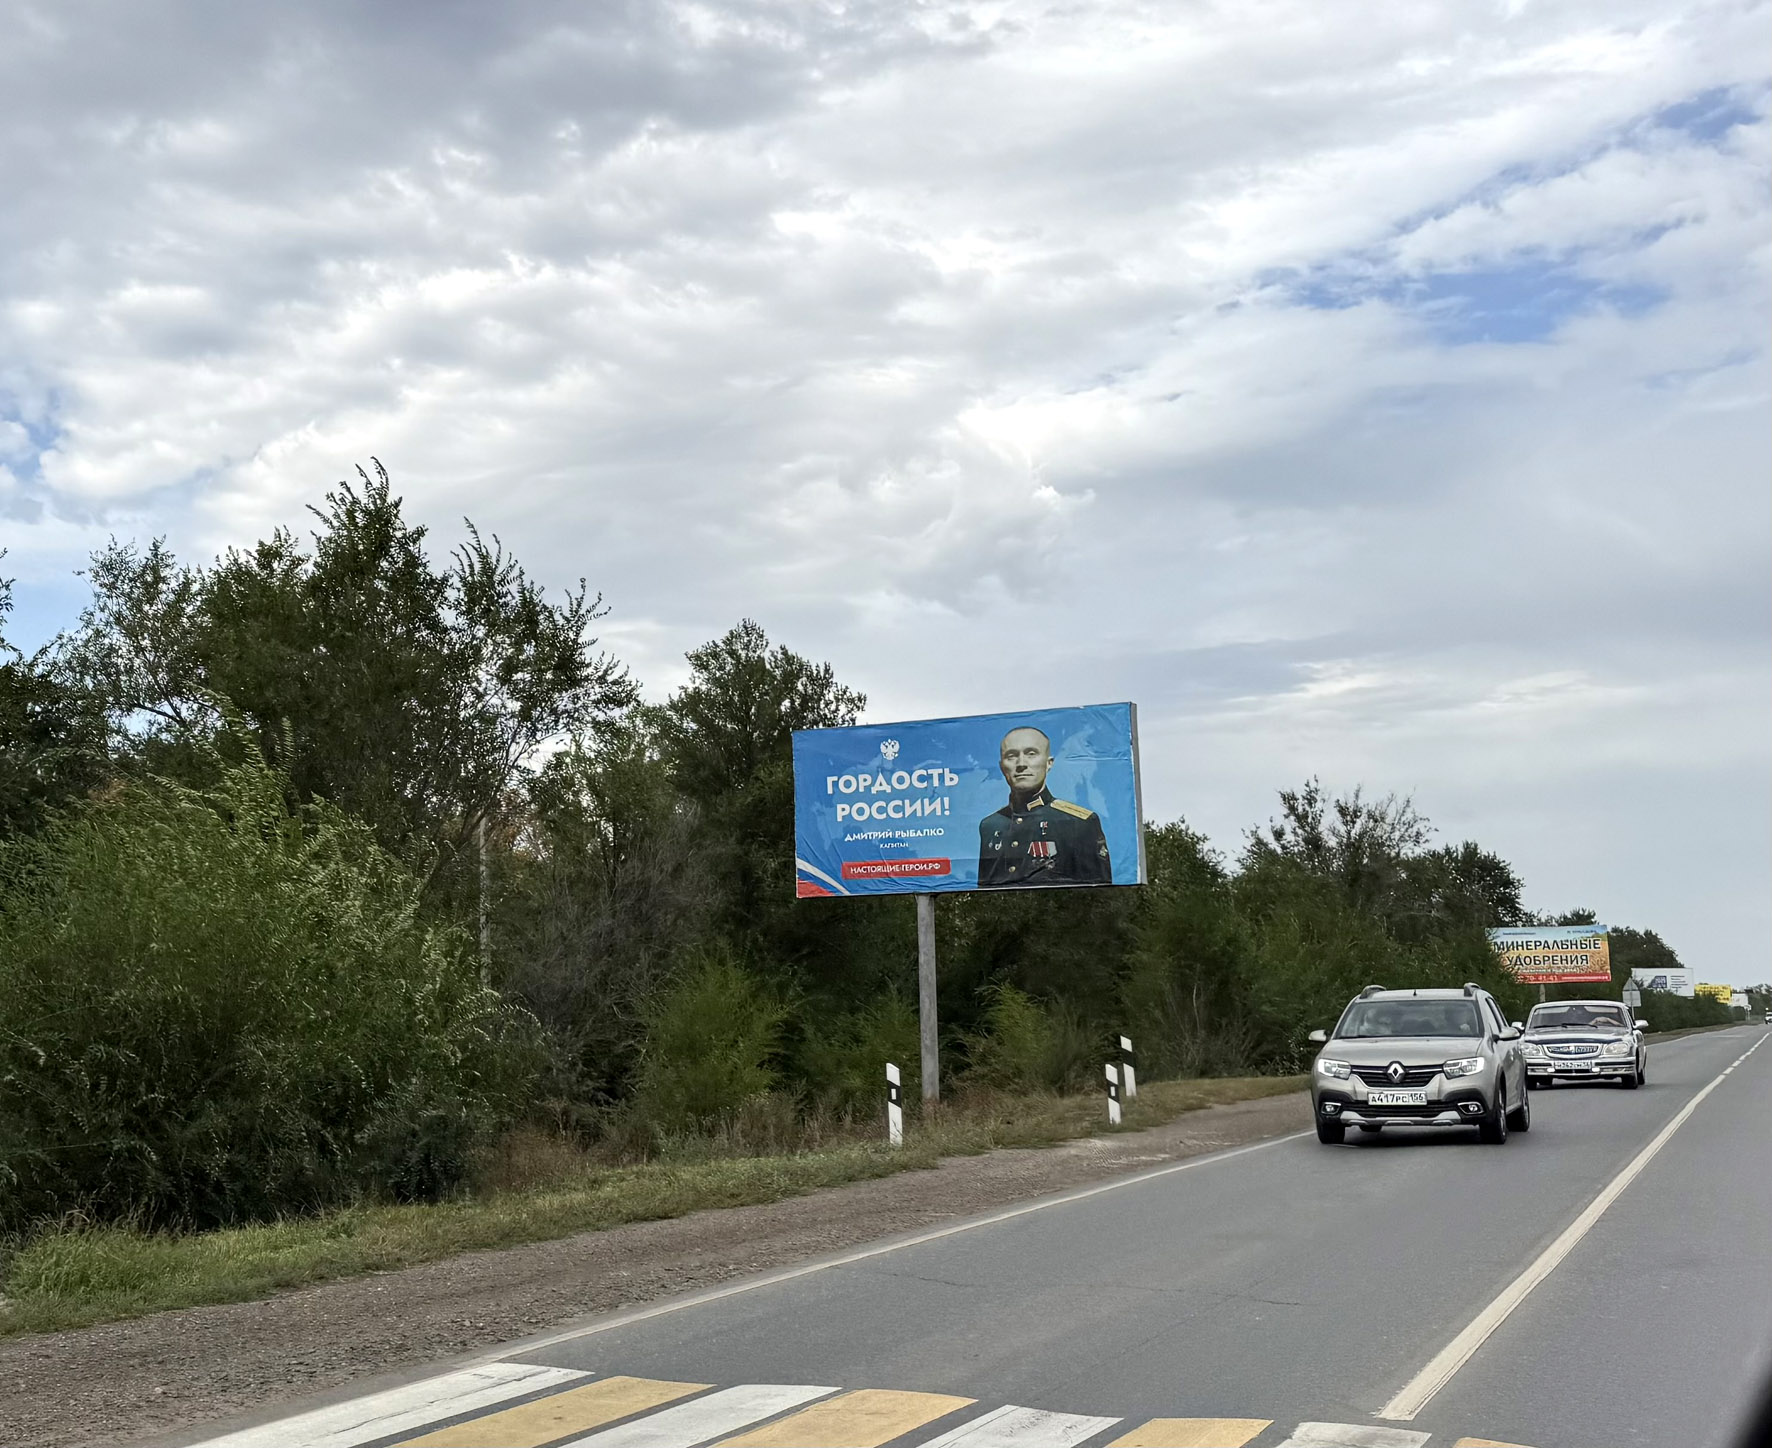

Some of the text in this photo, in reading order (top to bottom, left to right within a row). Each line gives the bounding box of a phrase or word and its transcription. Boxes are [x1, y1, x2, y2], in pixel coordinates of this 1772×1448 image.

[826, 768, 959, 795] ГОРДОСТЬ
[836, 797, 950, 822] РОССИИ!
[844, 828, 945, 842] ДМИТРИЙ РЫБАЛКО
[1493, 939, 1601, 952] МИНЕРАЛЬНЫЕ
[1506, 954, 1589, 967] УДОБРЕНИЯ
